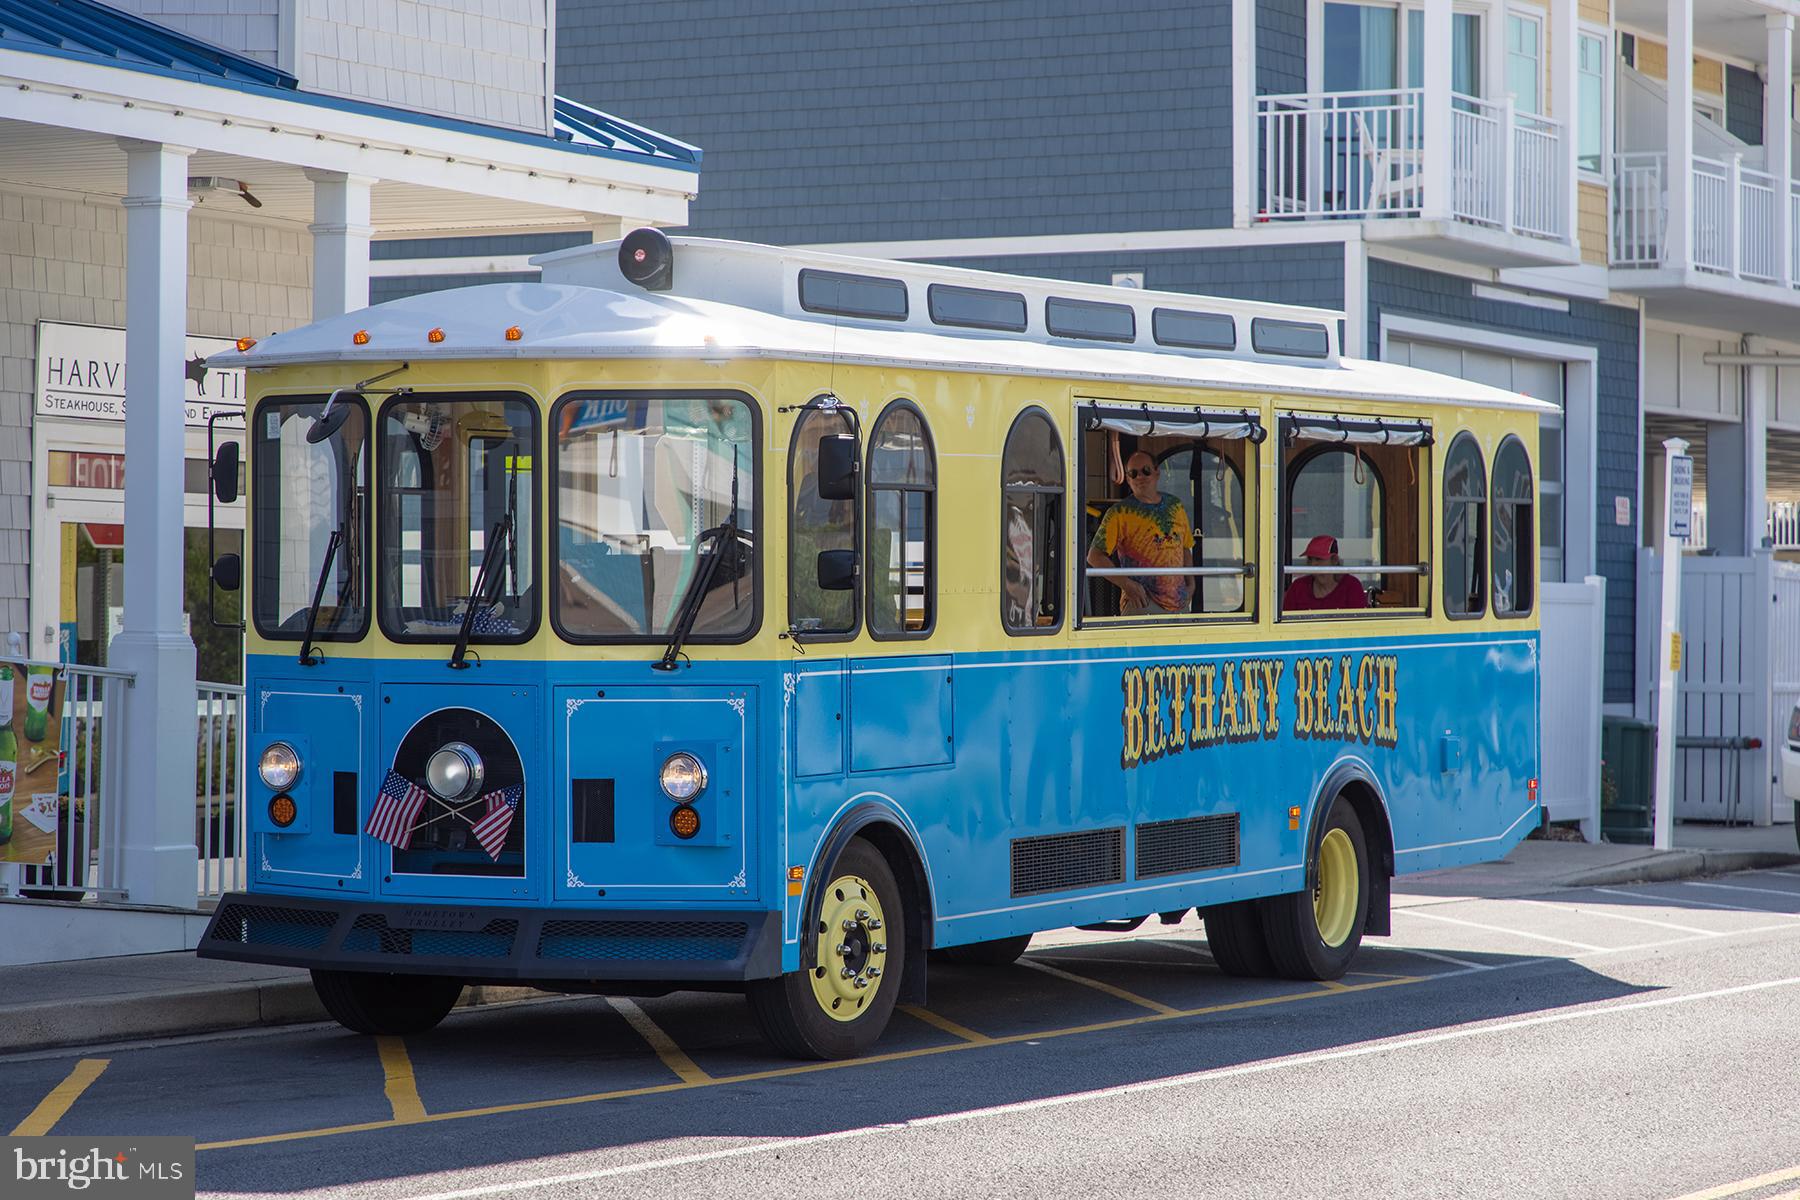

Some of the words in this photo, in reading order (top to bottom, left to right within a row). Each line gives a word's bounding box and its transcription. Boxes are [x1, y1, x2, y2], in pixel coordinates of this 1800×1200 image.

[48, 357, 126, 390] HARV
[45, 394, 118, 415] STEAKHOUSE,
[185, 408, 197, 419] ND
[1121, 657, 1284, 770] BETHANY
[1294, 652, 1398, 749] BEACH
